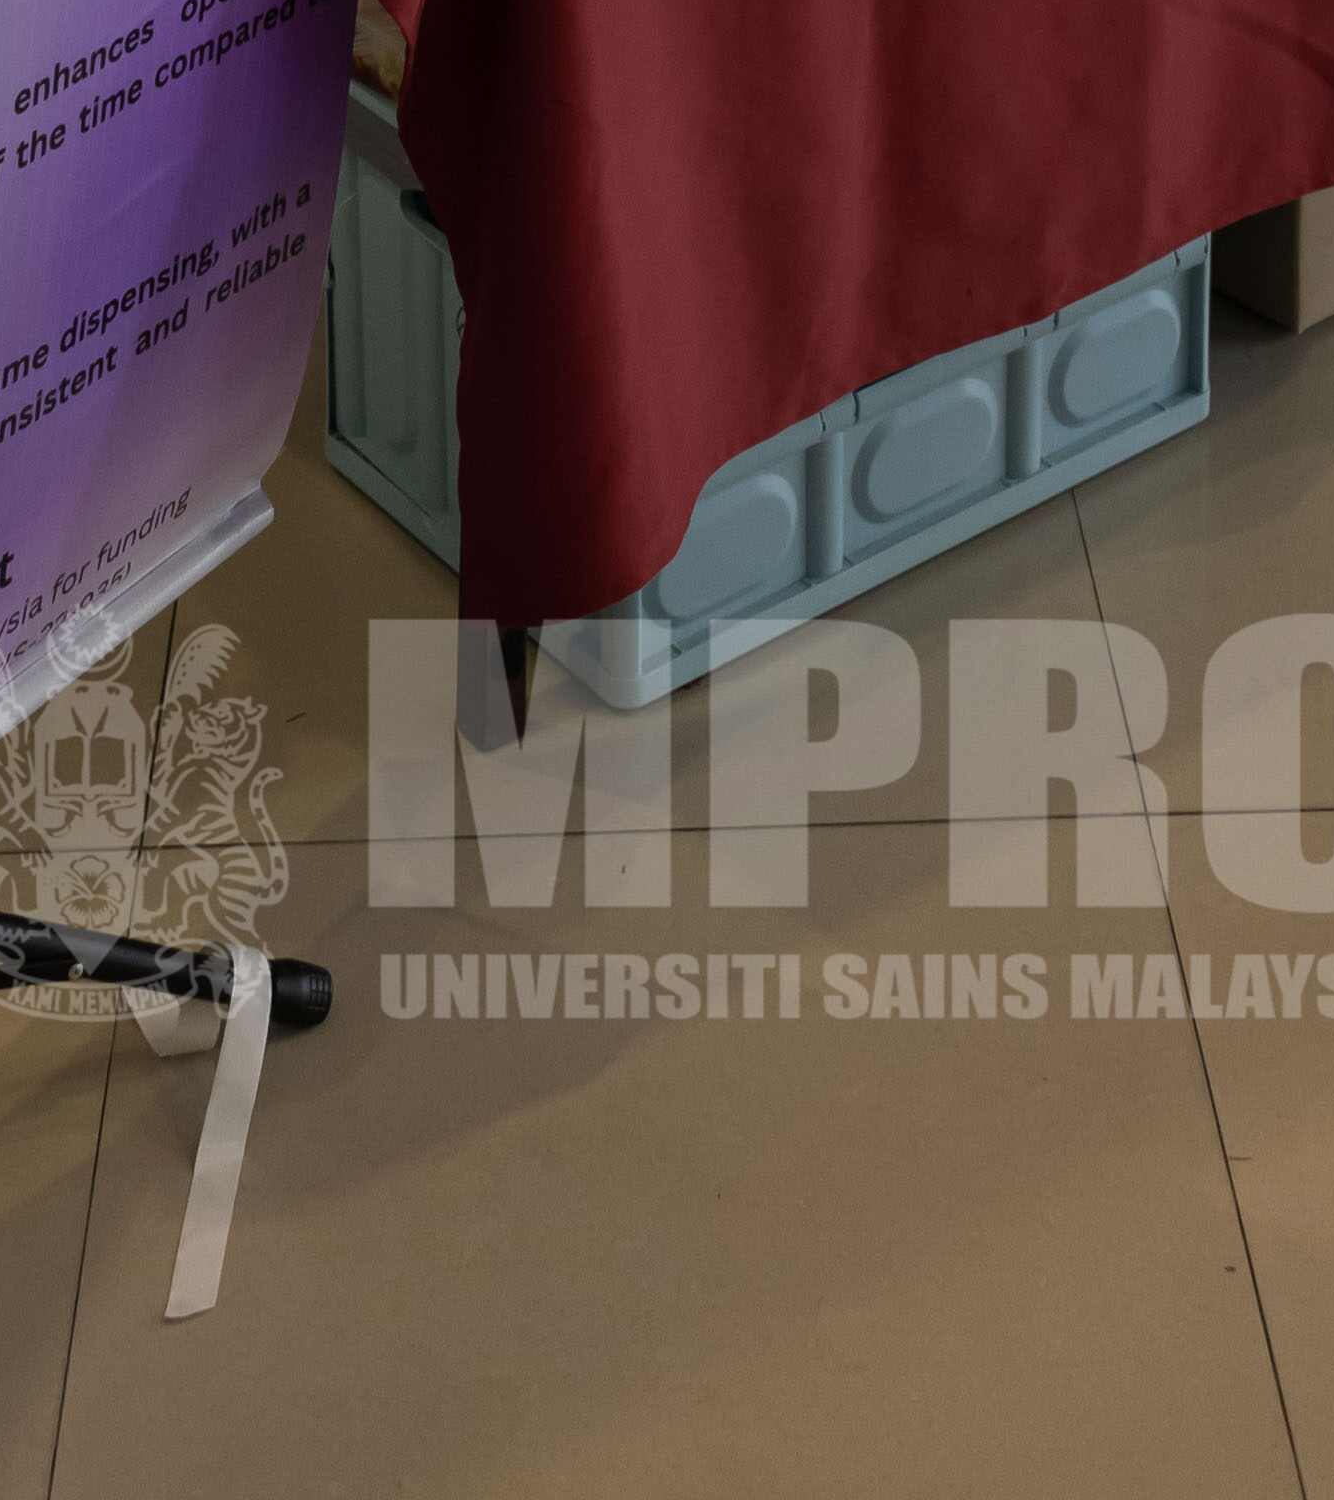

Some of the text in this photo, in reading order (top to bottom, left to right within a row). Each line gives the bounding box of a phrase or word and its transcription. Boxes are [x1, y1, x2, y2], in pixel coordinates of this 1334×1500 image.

[15, 21, 153, 113] enhances
[18, 125, 65, 168] the
[80, 80, 141, 132] time
[61, 242, 218, 351] dispensing,
[234, 195, 285, 245] with
[136, 299, 187, 354] and
[207, 235, 304, 309] reliable
